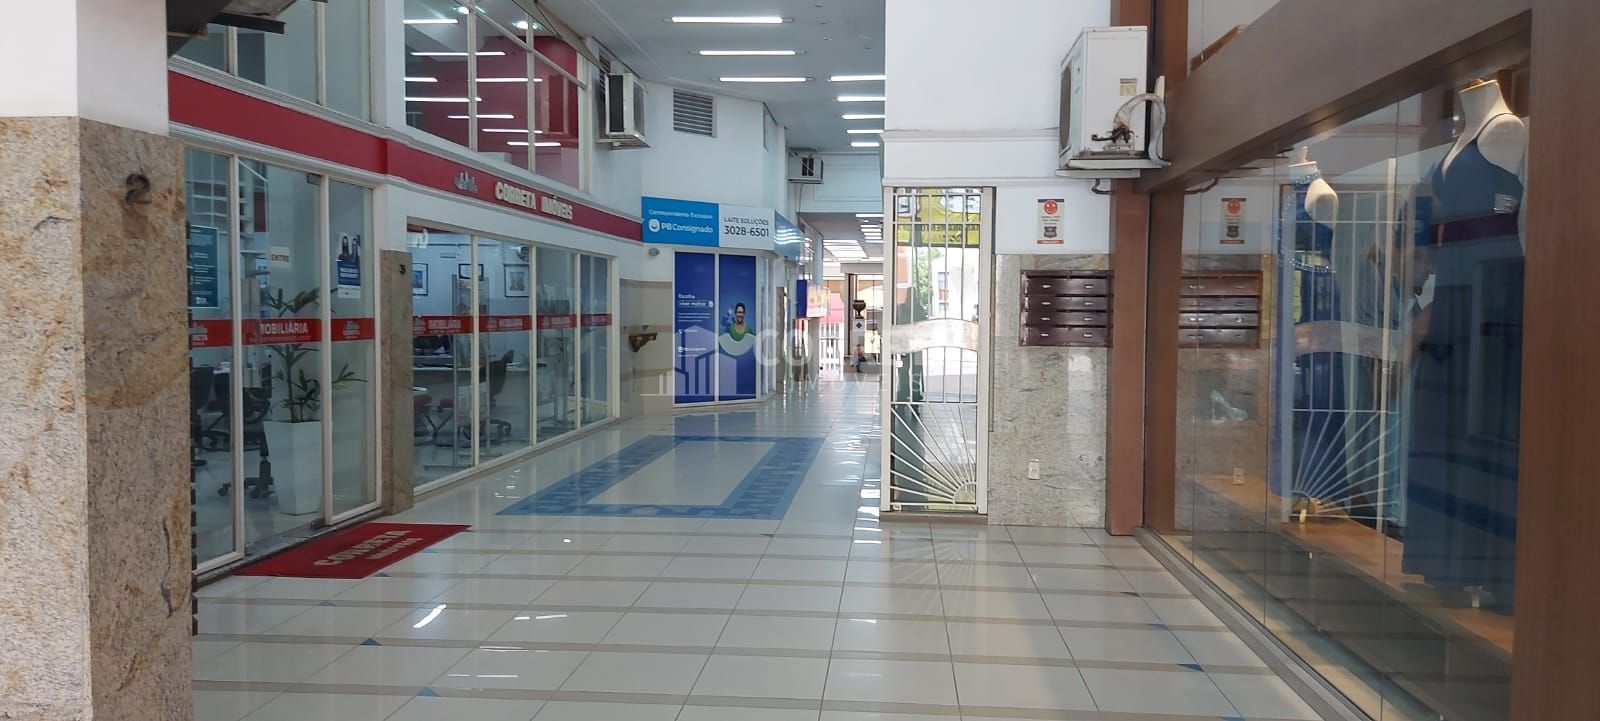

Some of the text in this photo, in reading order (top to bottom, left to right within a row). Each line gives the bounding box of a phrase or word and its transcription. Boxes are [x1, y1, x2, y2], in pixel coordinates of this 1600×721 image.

[125, 173, 153, 205] 2
[495, 182, 536, 209] CORRETA
[723, 225, 770, 238] 3028-6501
